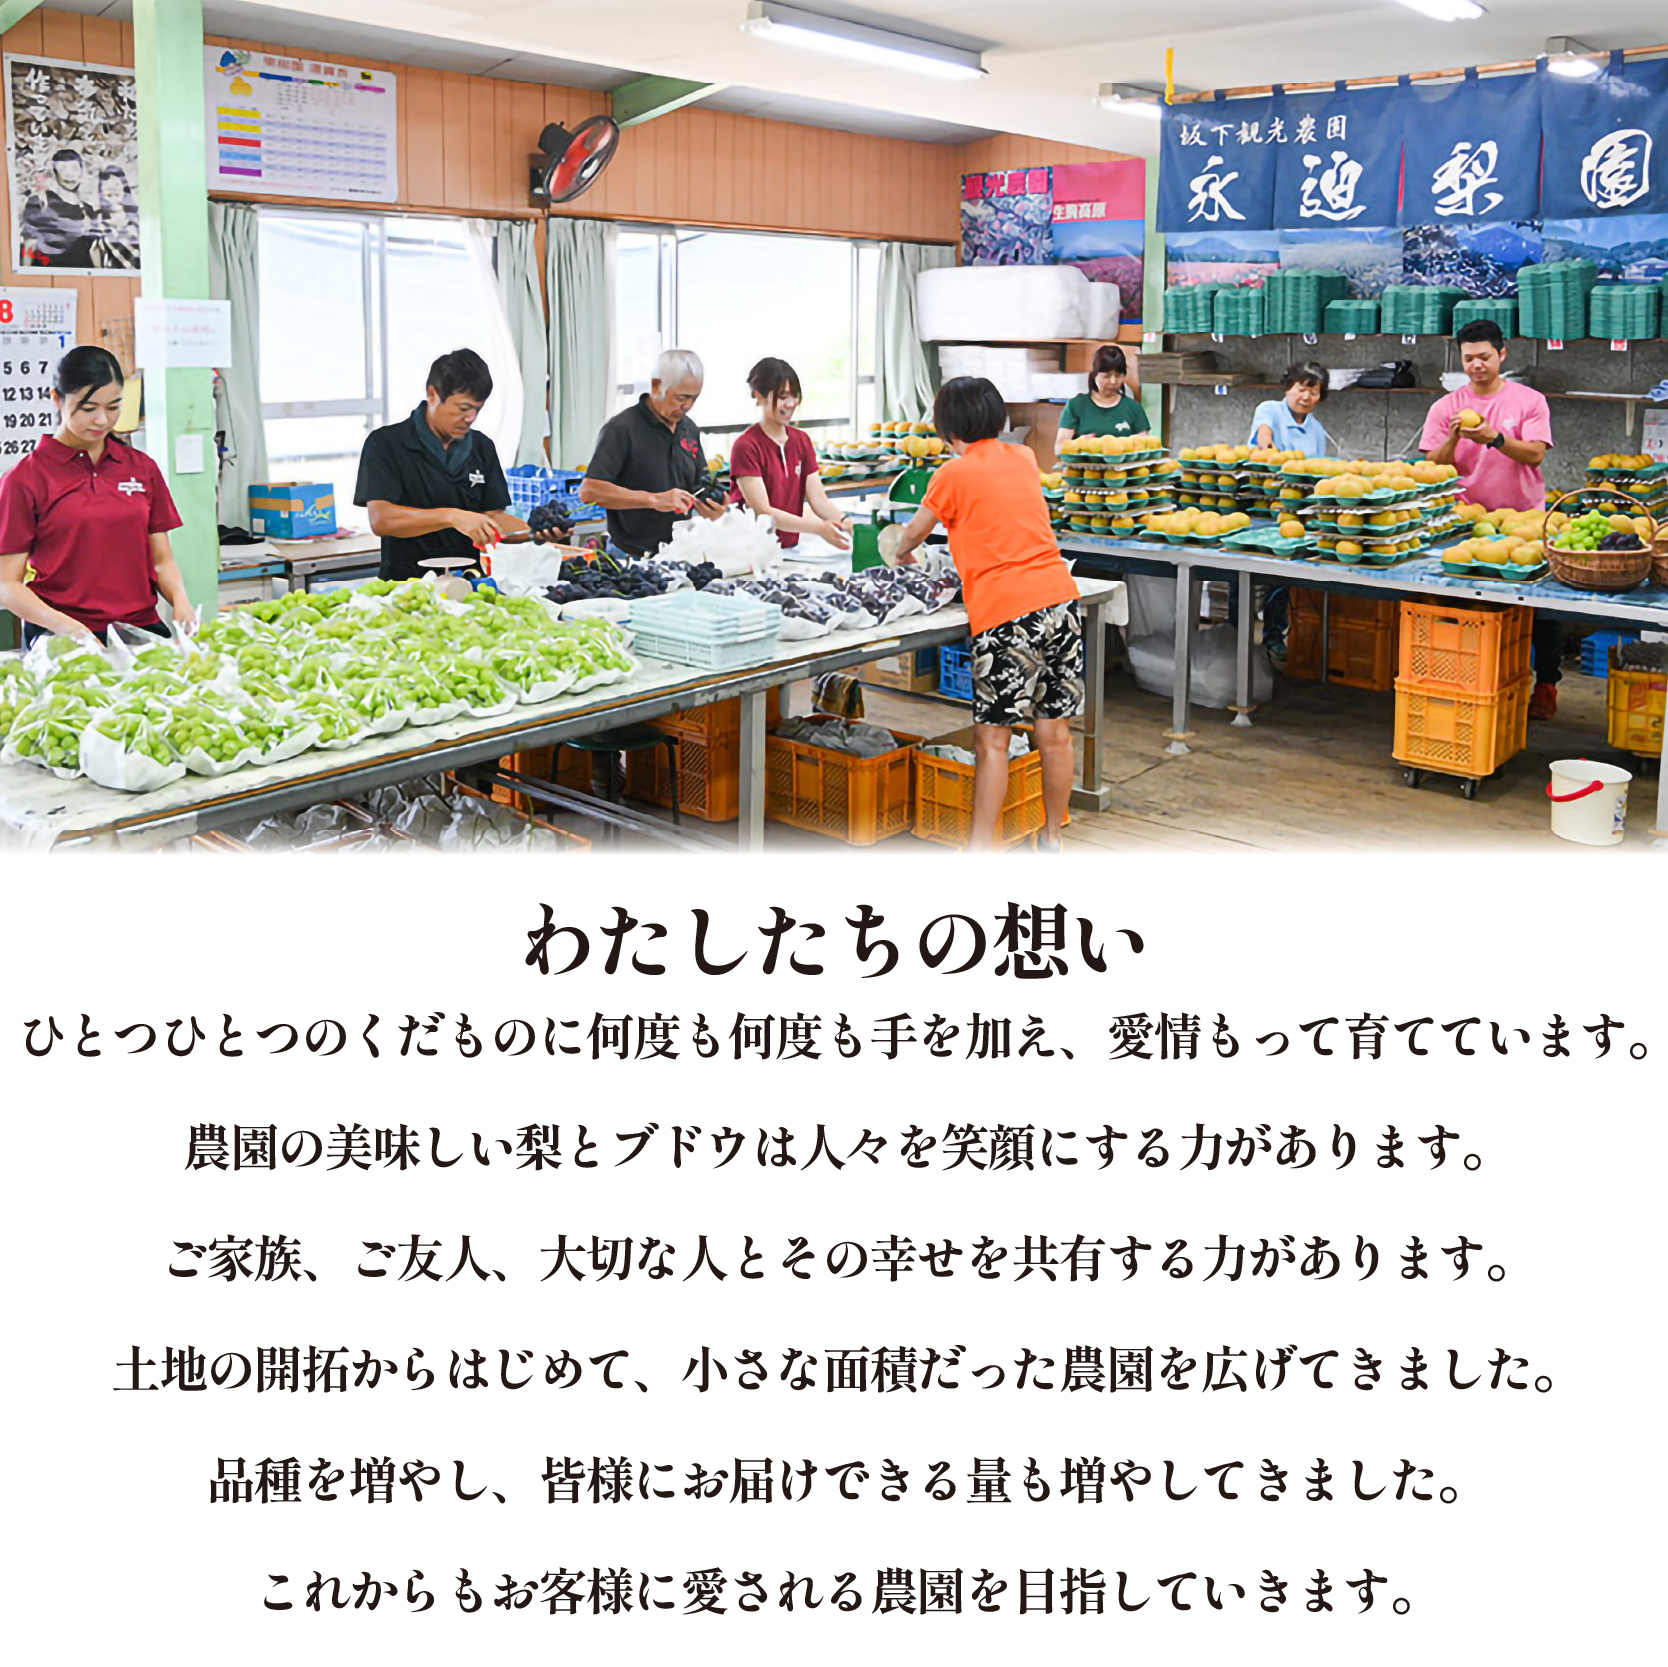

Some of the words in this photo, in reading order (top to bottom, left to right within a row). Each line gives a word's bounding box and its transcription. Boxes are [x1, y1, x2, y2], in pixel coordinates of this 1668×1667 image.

[0, 299, 13, 323] 8
[58, 335, 65, 348] 1
[3, 361, 13, 375] 5
[20, 361, 30, 375] 6
[39, 361, 48, 374] 7
[2, 387, 17, 401] 12
[19, 387, 34, 401] 13
[37, 386, 51, 400] 14
[3, 413, 17, 428] 19
[19, 413, 35, 427] 20
[38, 412, 52, 426] 21
[3, 440, 19, 454] 26
[20, 439, 36, 453] 27
